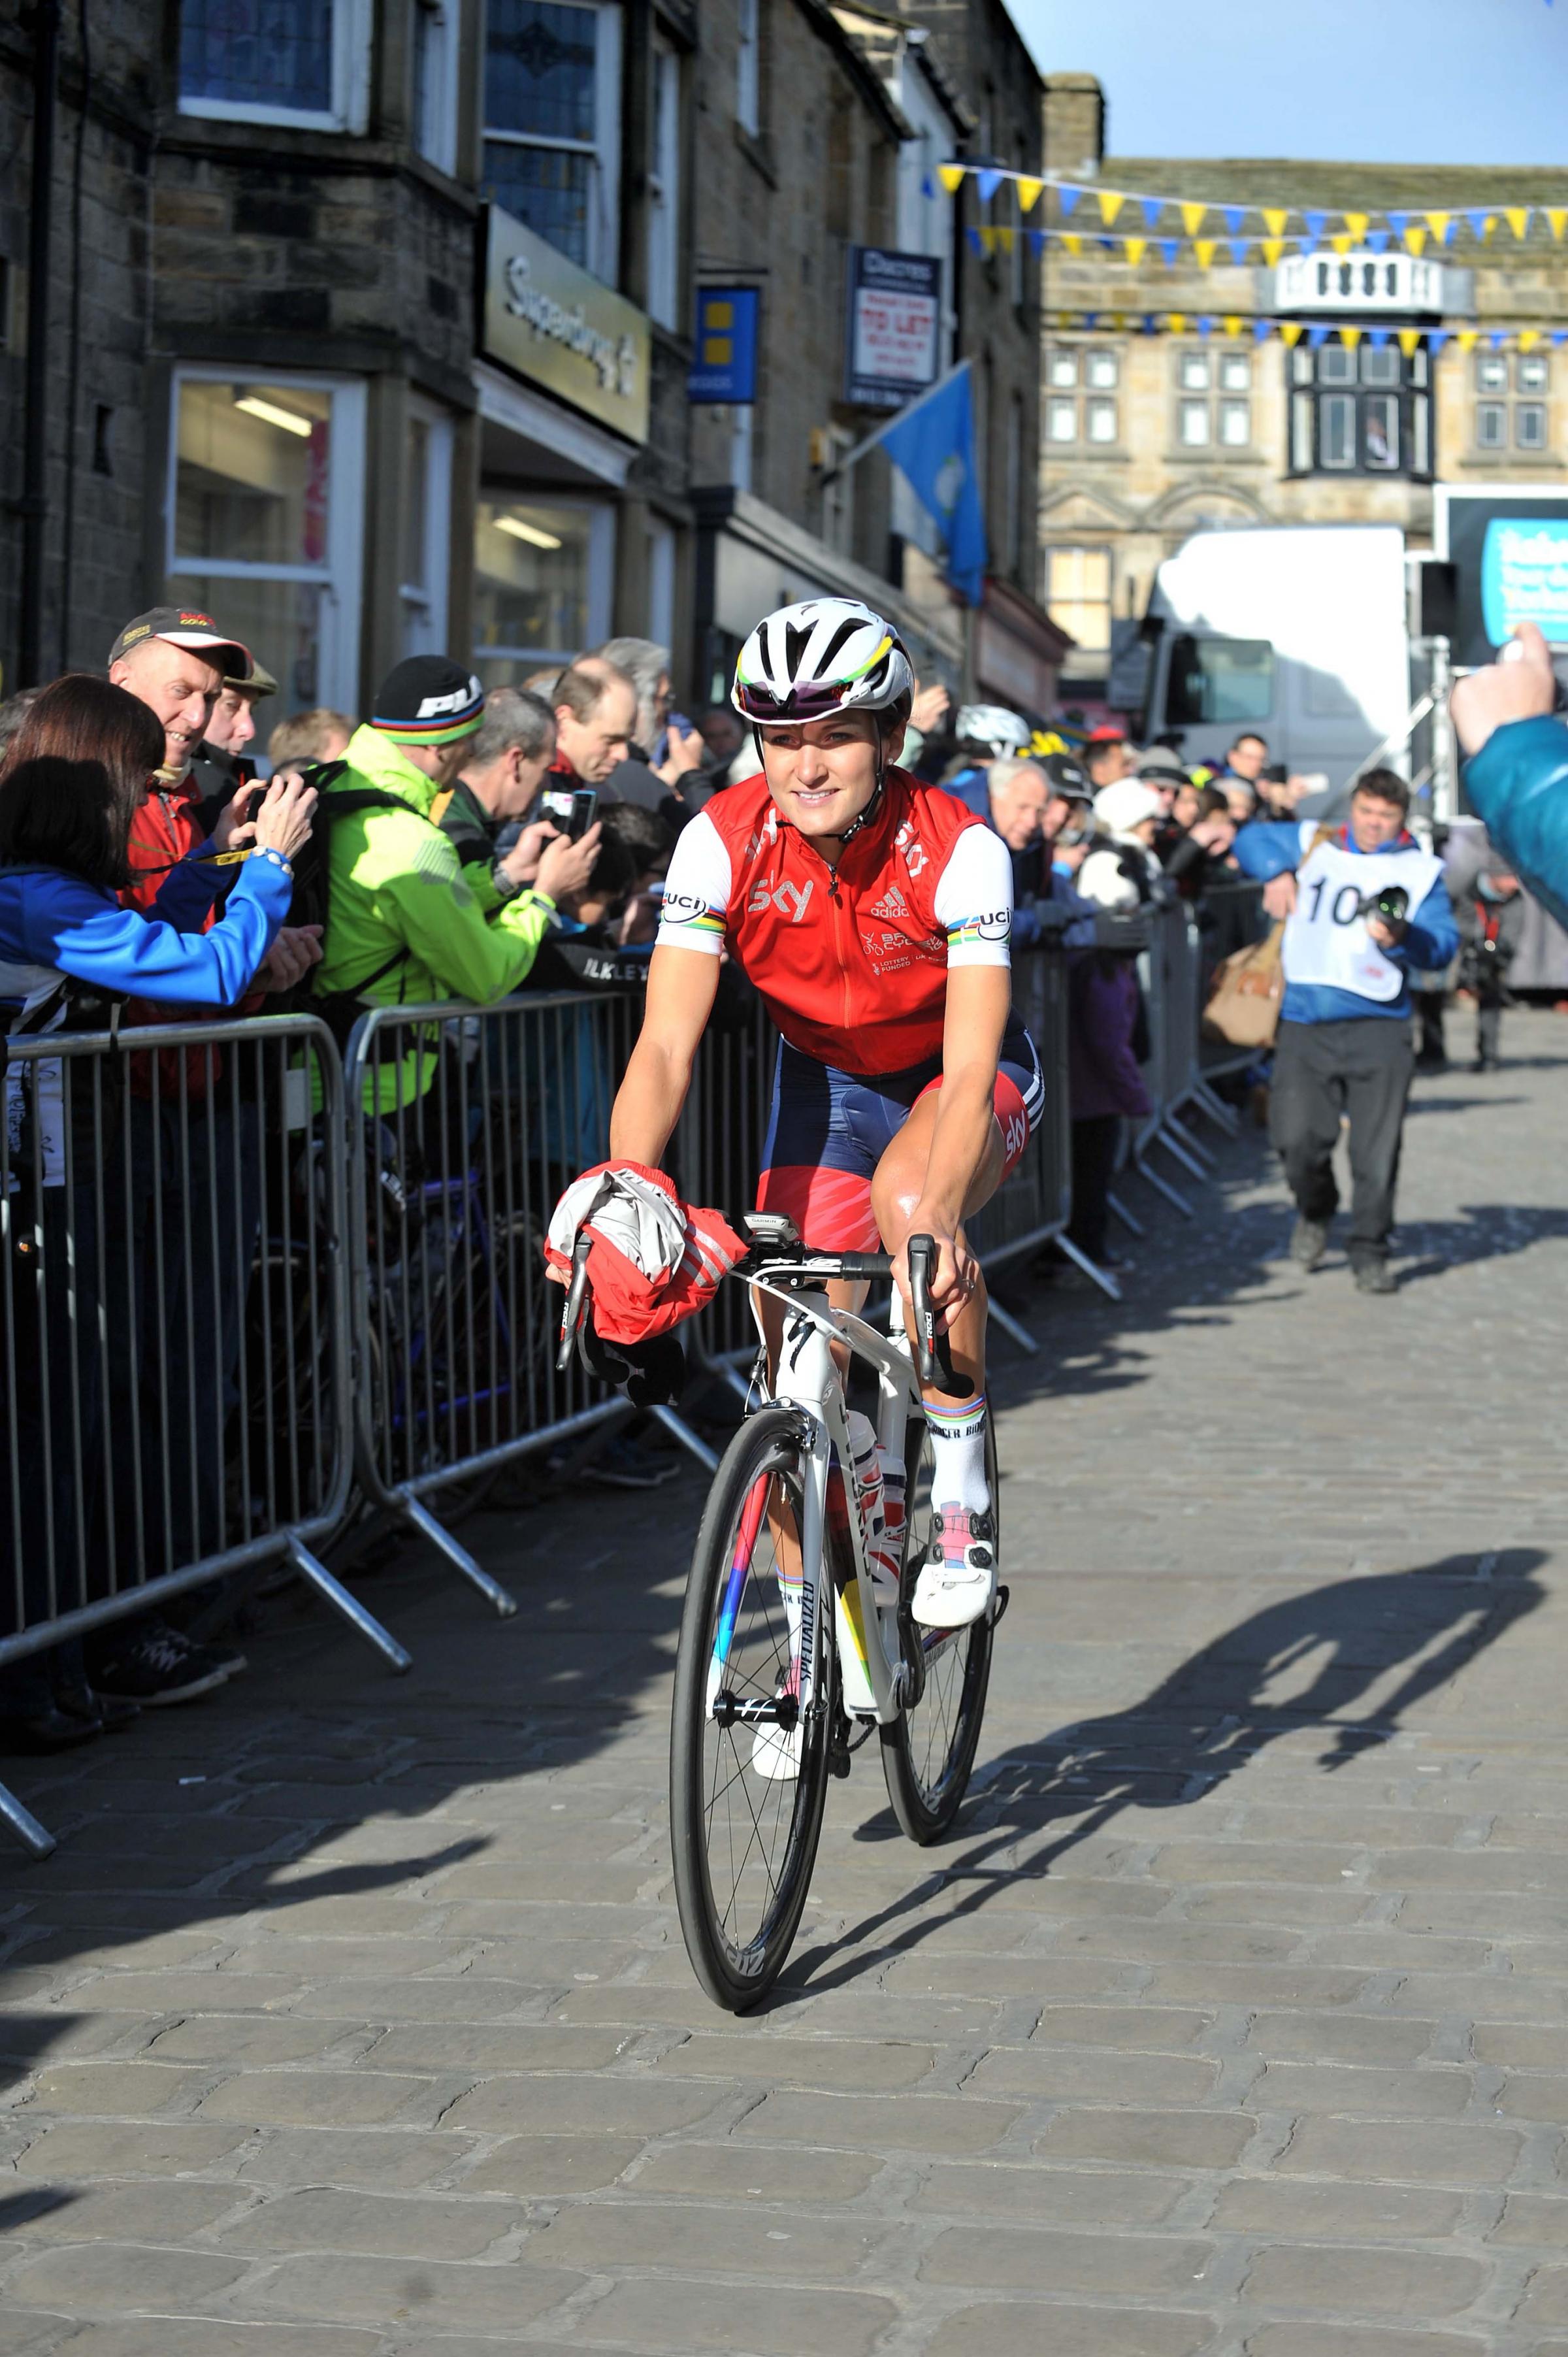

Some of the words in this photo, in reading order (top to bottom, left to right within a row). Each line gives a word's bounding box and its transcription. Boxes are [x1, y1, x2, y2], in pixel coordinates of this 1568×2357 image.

[862, 308, 887, 331] TO
[895, 314, 931, 335] LET
[871, 903, 909, 918] adida
[879, 956, 909, 967] LOTTERY
[881, 961, 911, 972] FUNDED
[800, 1580, 814, 1685] SPECIALIZED
